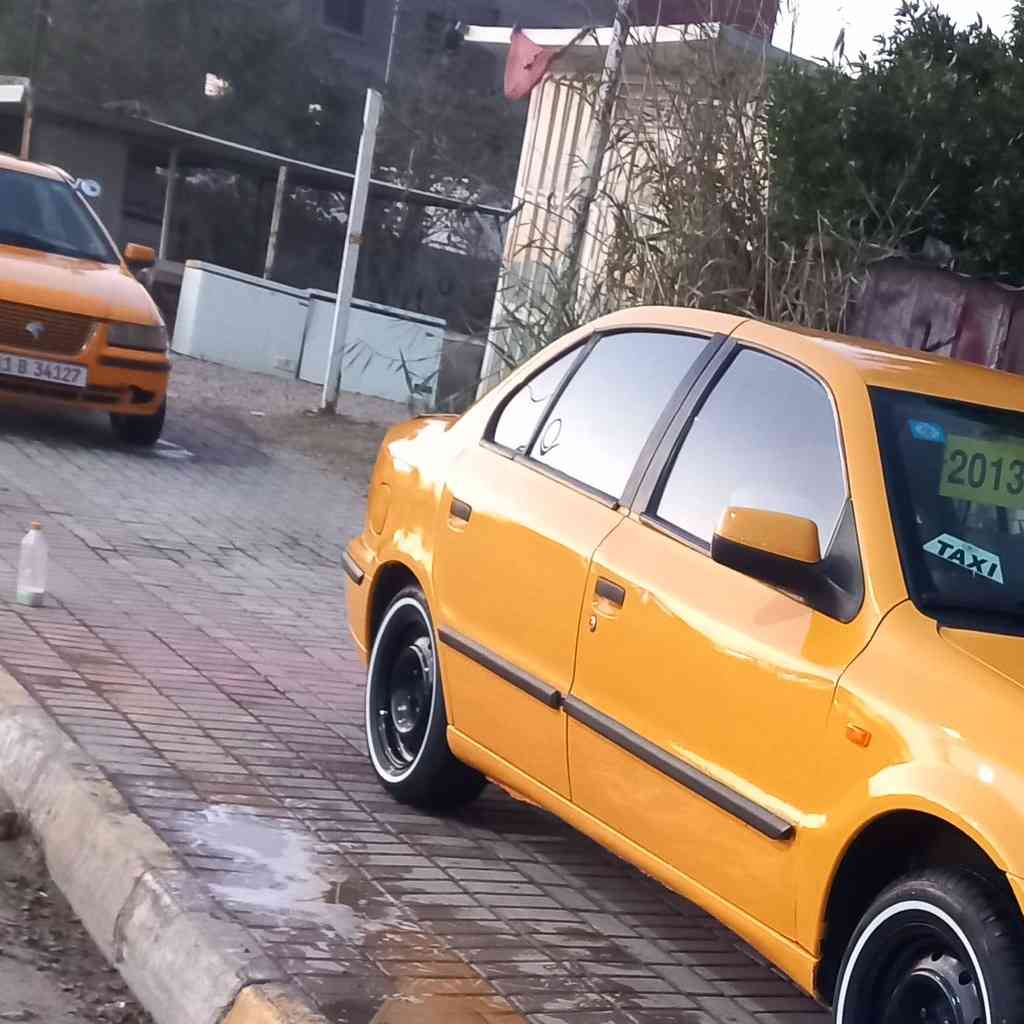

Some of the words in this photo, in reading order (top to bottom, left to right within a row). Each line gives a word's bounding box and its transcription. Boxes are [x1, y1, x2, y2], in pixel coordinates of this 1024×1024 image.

[33, 361, 81, 383] 34127
[948, 449, 1024, 495] 2013
[937, 539, 998, 578] TAXI
